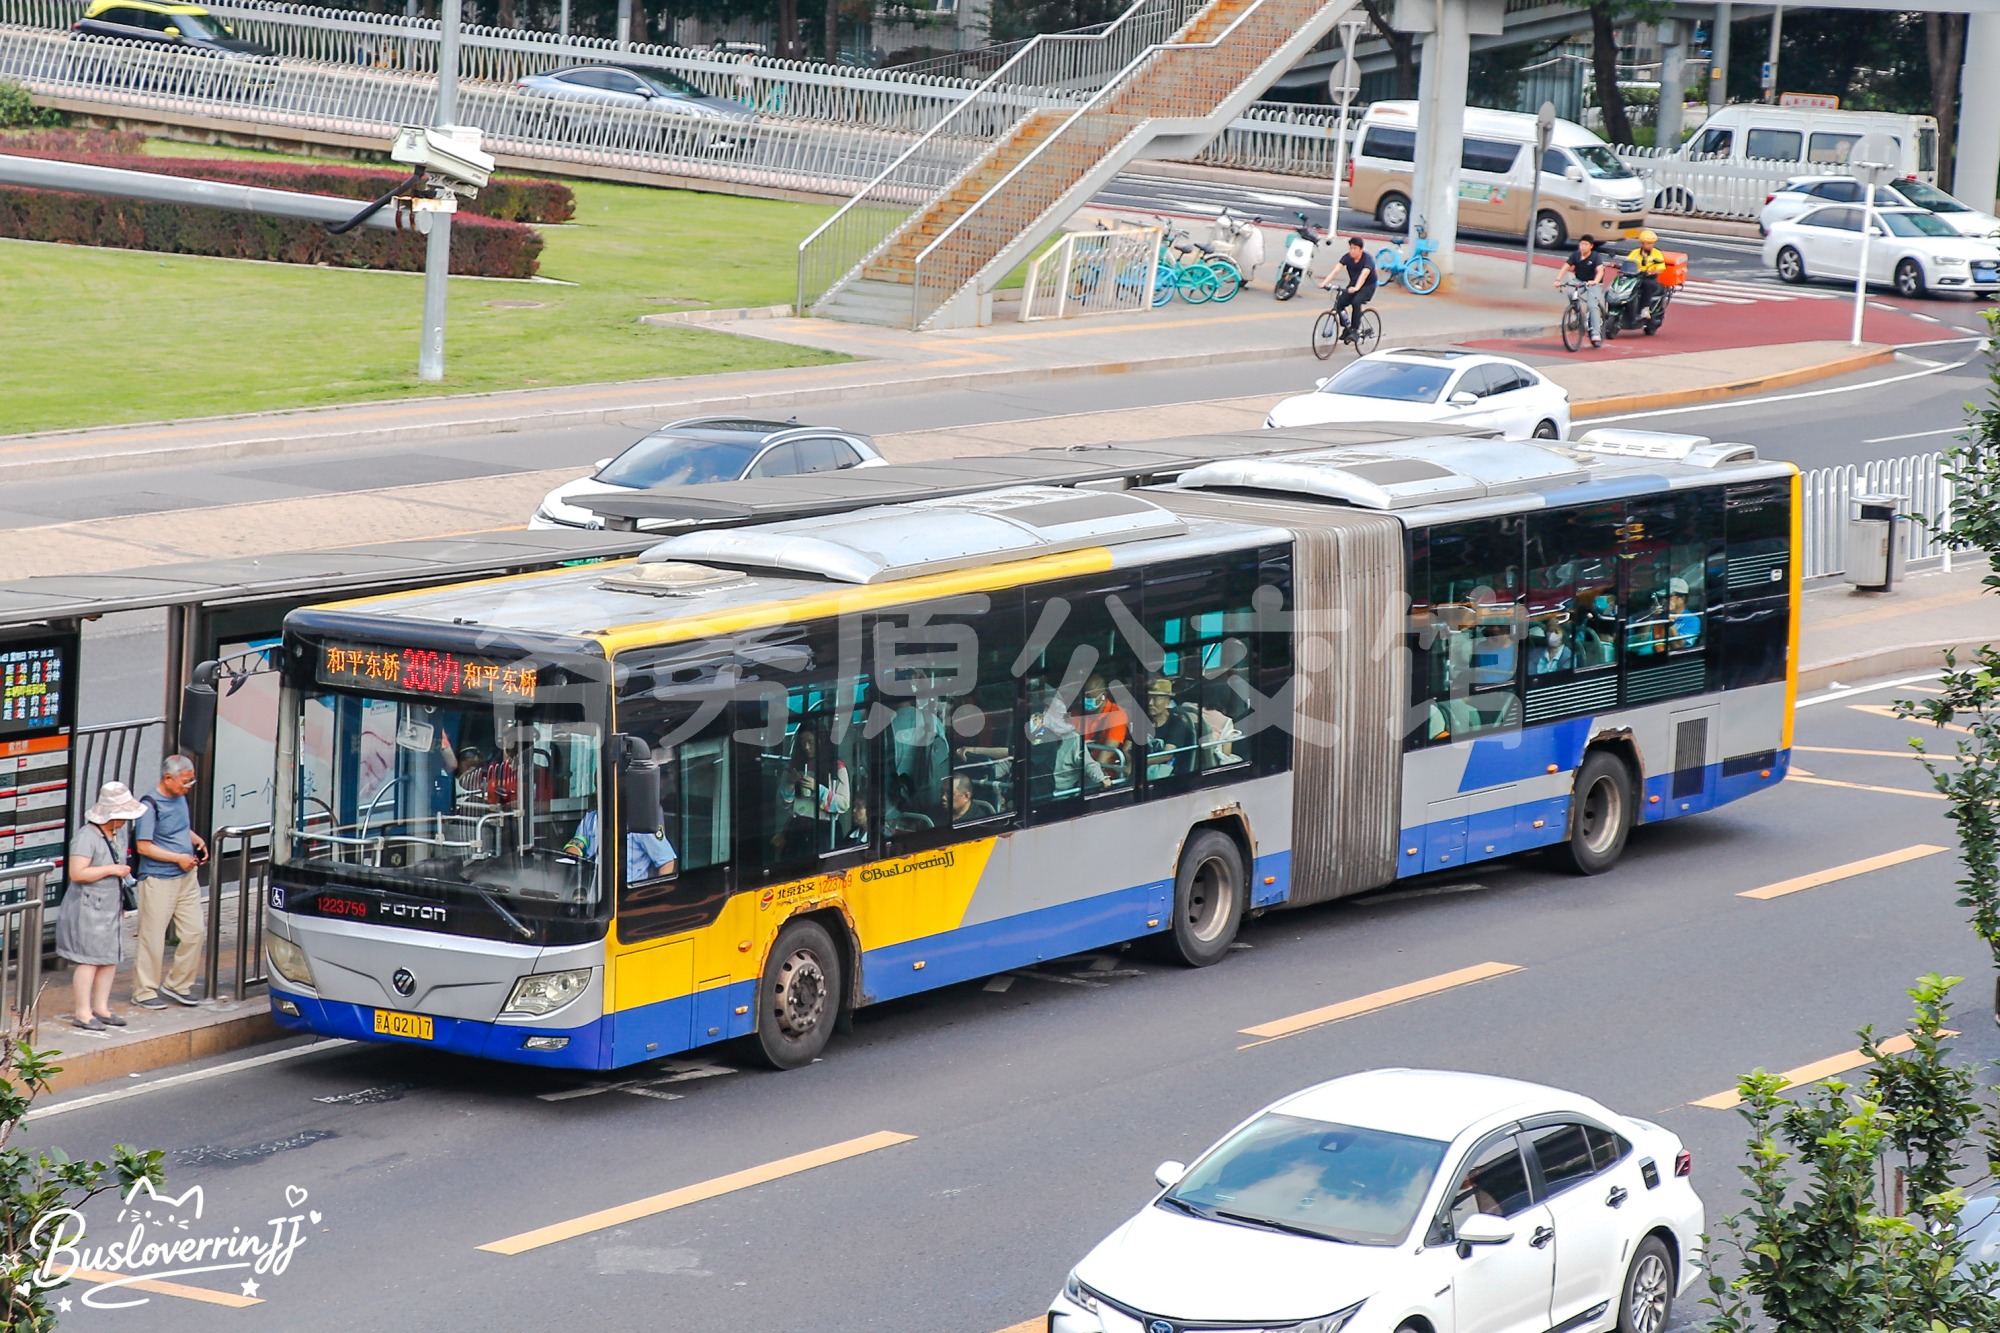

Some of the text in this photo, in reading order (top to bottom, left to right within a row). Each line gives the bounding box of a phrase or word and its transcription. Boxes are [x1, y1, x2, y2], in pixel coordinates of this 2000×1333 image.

[327, 646, 400, 682] 和平东桥
[463, 661, 537, 698] 和平东桥
[777, 882, 815, 900] 北京公交
[317, 898, 447, 922] 1223759 FOTON
